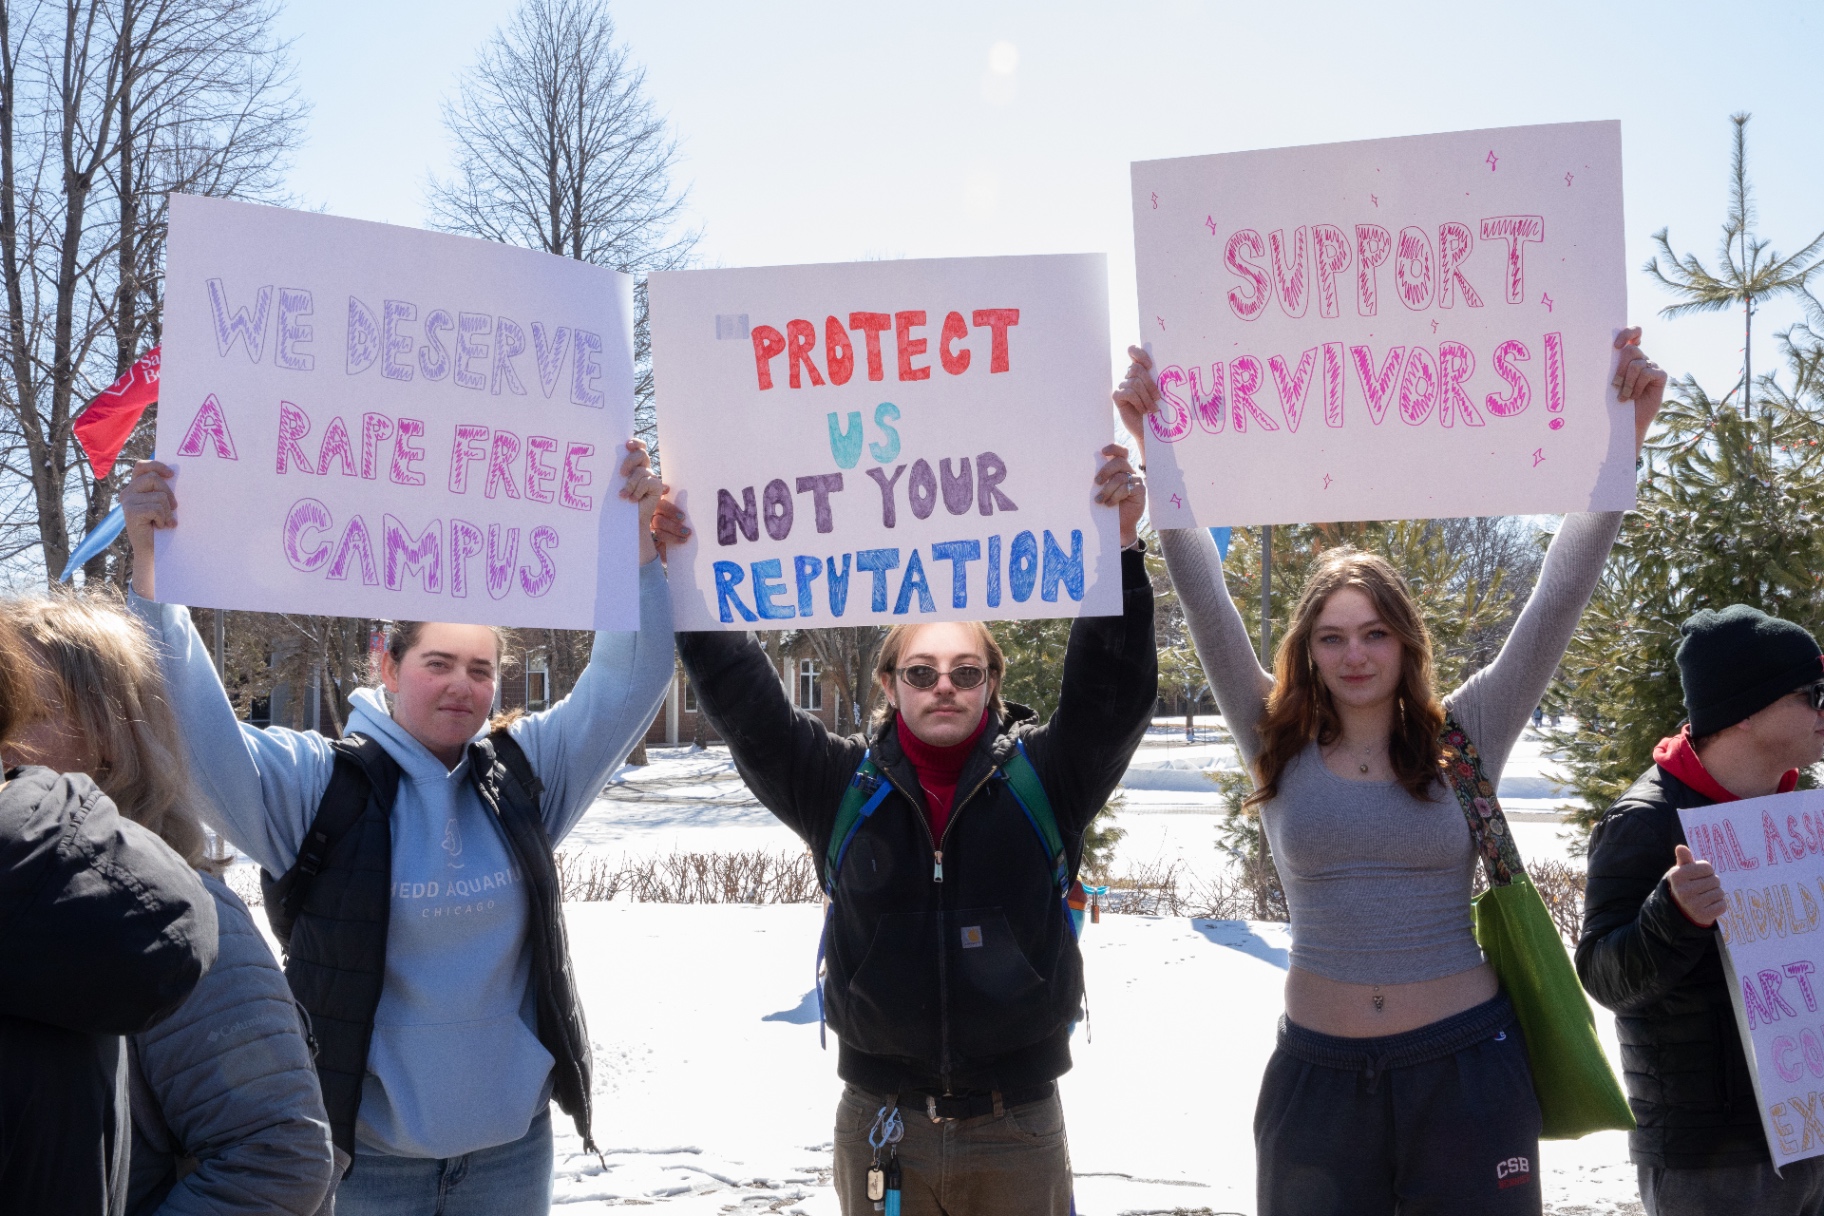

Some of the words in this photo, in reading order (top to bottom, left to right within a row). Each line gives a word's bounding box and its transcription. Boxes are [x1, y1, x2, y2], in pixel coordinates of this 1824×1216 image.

[1224, 215, 1544, 321] SUPPORT
[206, 278, 315, 371] WE
[346, 295, 605, 409] DESERVE
[751, 308, 1020, 391] PROTECT
[1149, 332, 1566, 443] SURVIVORS!
[177, 393, 239, 461] A
[276, 400, 426, 486] RAPE
[448, 424, 595, 511] FREE
[827, 402, 901, 469] US
[716, 472, 844, 546] NOT
[866, 451, 1019, 529] YOUR
[283, 498, 559, 600] CAMPUS
[712, 529, 1085, 624] REPUTATION
[422, 900, 495, 918] CHICAGO
[1742, 960, 1815, 1031] ART
[1772, 1024, 1824, 1083] CO
[1496, 1156, 1529, 1179] CSB
[1769, 1091, 1824, 1156] EX
